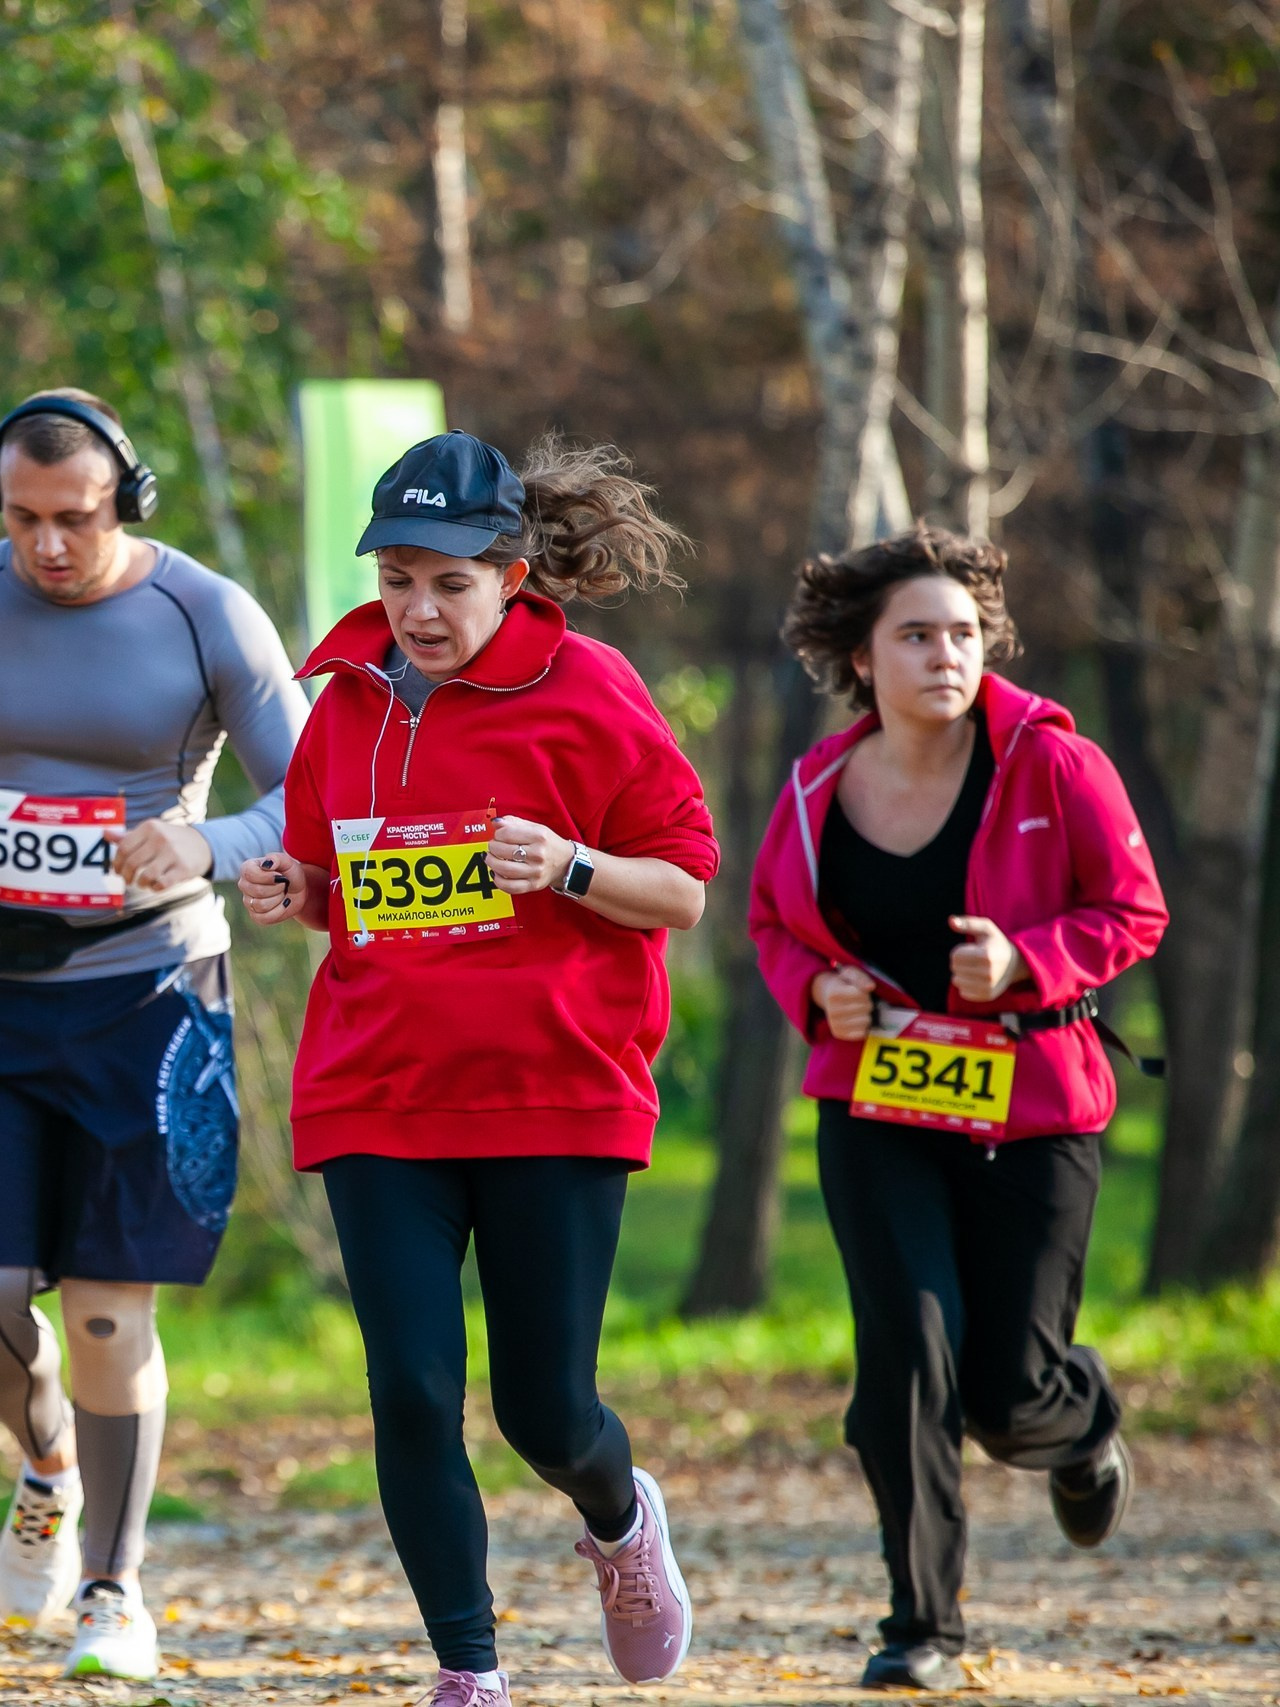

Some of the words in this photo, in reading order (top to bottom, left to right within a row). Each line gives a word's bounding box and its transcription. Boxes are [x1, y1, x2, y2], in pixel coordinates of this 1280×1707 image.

[402, 488, 446, 508] FILA
[386, 822, 445, 834] КРАСНОЯРСКИЕ
[464, 825, 471, 834] 5
[471, 823, 486, 832] КМ
[402, 831, 429, 840] МОСТЫ
[350, 851, 498, 910] 5394
[377, 910, 439, 922] МИХАЙЛОВА
[441, 906, 475, 918] ЮЛИЯ
[478, 922, 500, 932] 2026
[870, 1044, 995, 1102] 5341
